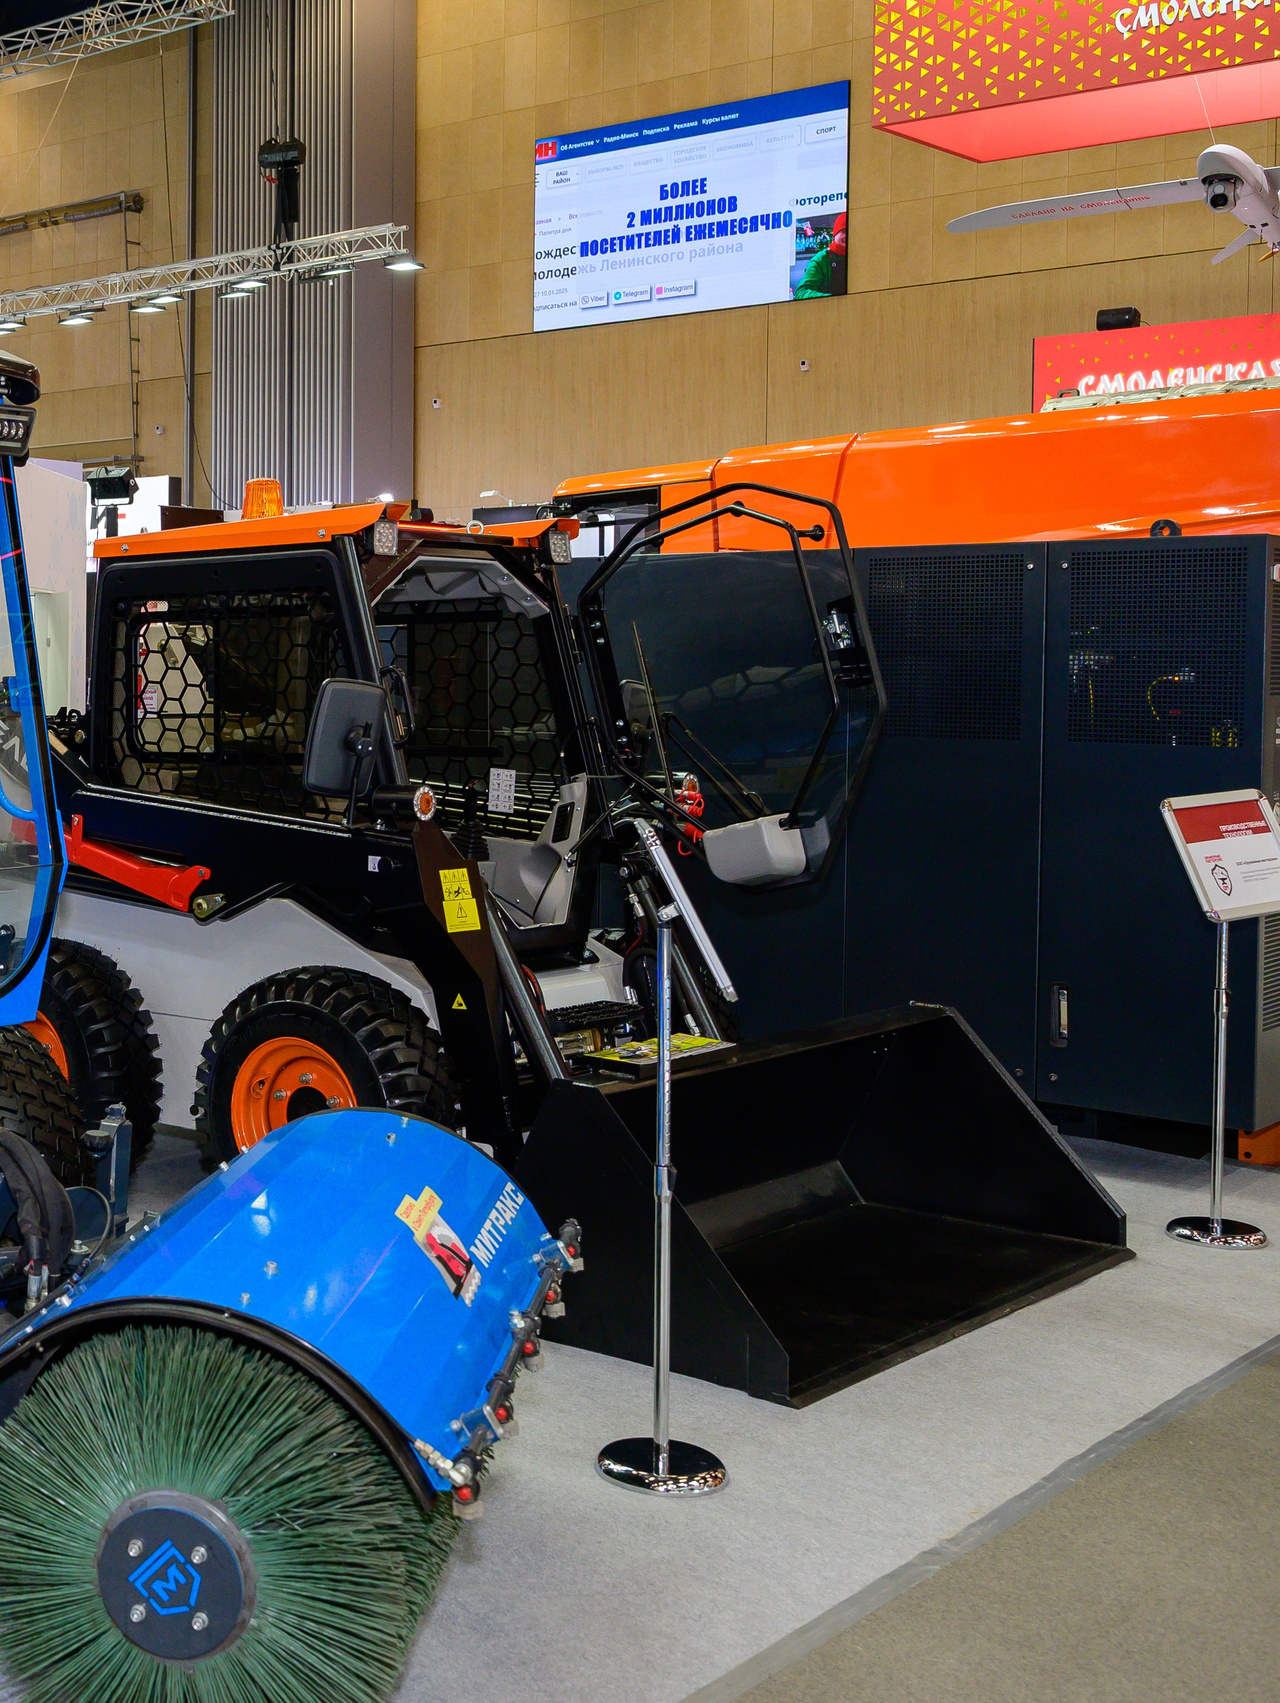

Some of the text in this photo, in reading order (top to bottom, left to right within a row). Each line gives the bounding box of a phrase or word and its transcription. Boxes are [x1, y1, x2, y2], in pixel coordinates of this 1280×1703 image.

[1115, 0, 1271, 34] СМОЛЕН
[701, 112, 740, 126] Курсы валют
[642, 125, 670, 136] Подписка
[673, 120, 698, 130] Реклама
[816, 125, 836, 135] СПОРТ
[603, 131, 639, 144] Радио-Минск
[568, 140, 594, 150] Агентстве
[555, 170, 568, 178] ВАШ
[552, 177, 571, 186] РАЙОН
[660, 177, 707, 201] БОЛЕЕ
[626, 196, 738, 229] 2 МИЛЛИОНОВ
[580, 210, 793, 258] ПОСЕТИТЕЛЕЙ ЕЖЕМЕСЯЧНО
[600, 251, 685, 272] Ленинского
[689, 242, 744, 262] района
[541, 288, 568, 297] 10.01.2025
[622, 288, 649, 298] Telegram
[664, 282, 694, 294] Instagram
[590, 295, 605, 303] Viber
[470, 1182, 524, 1268] МИТРАКС
